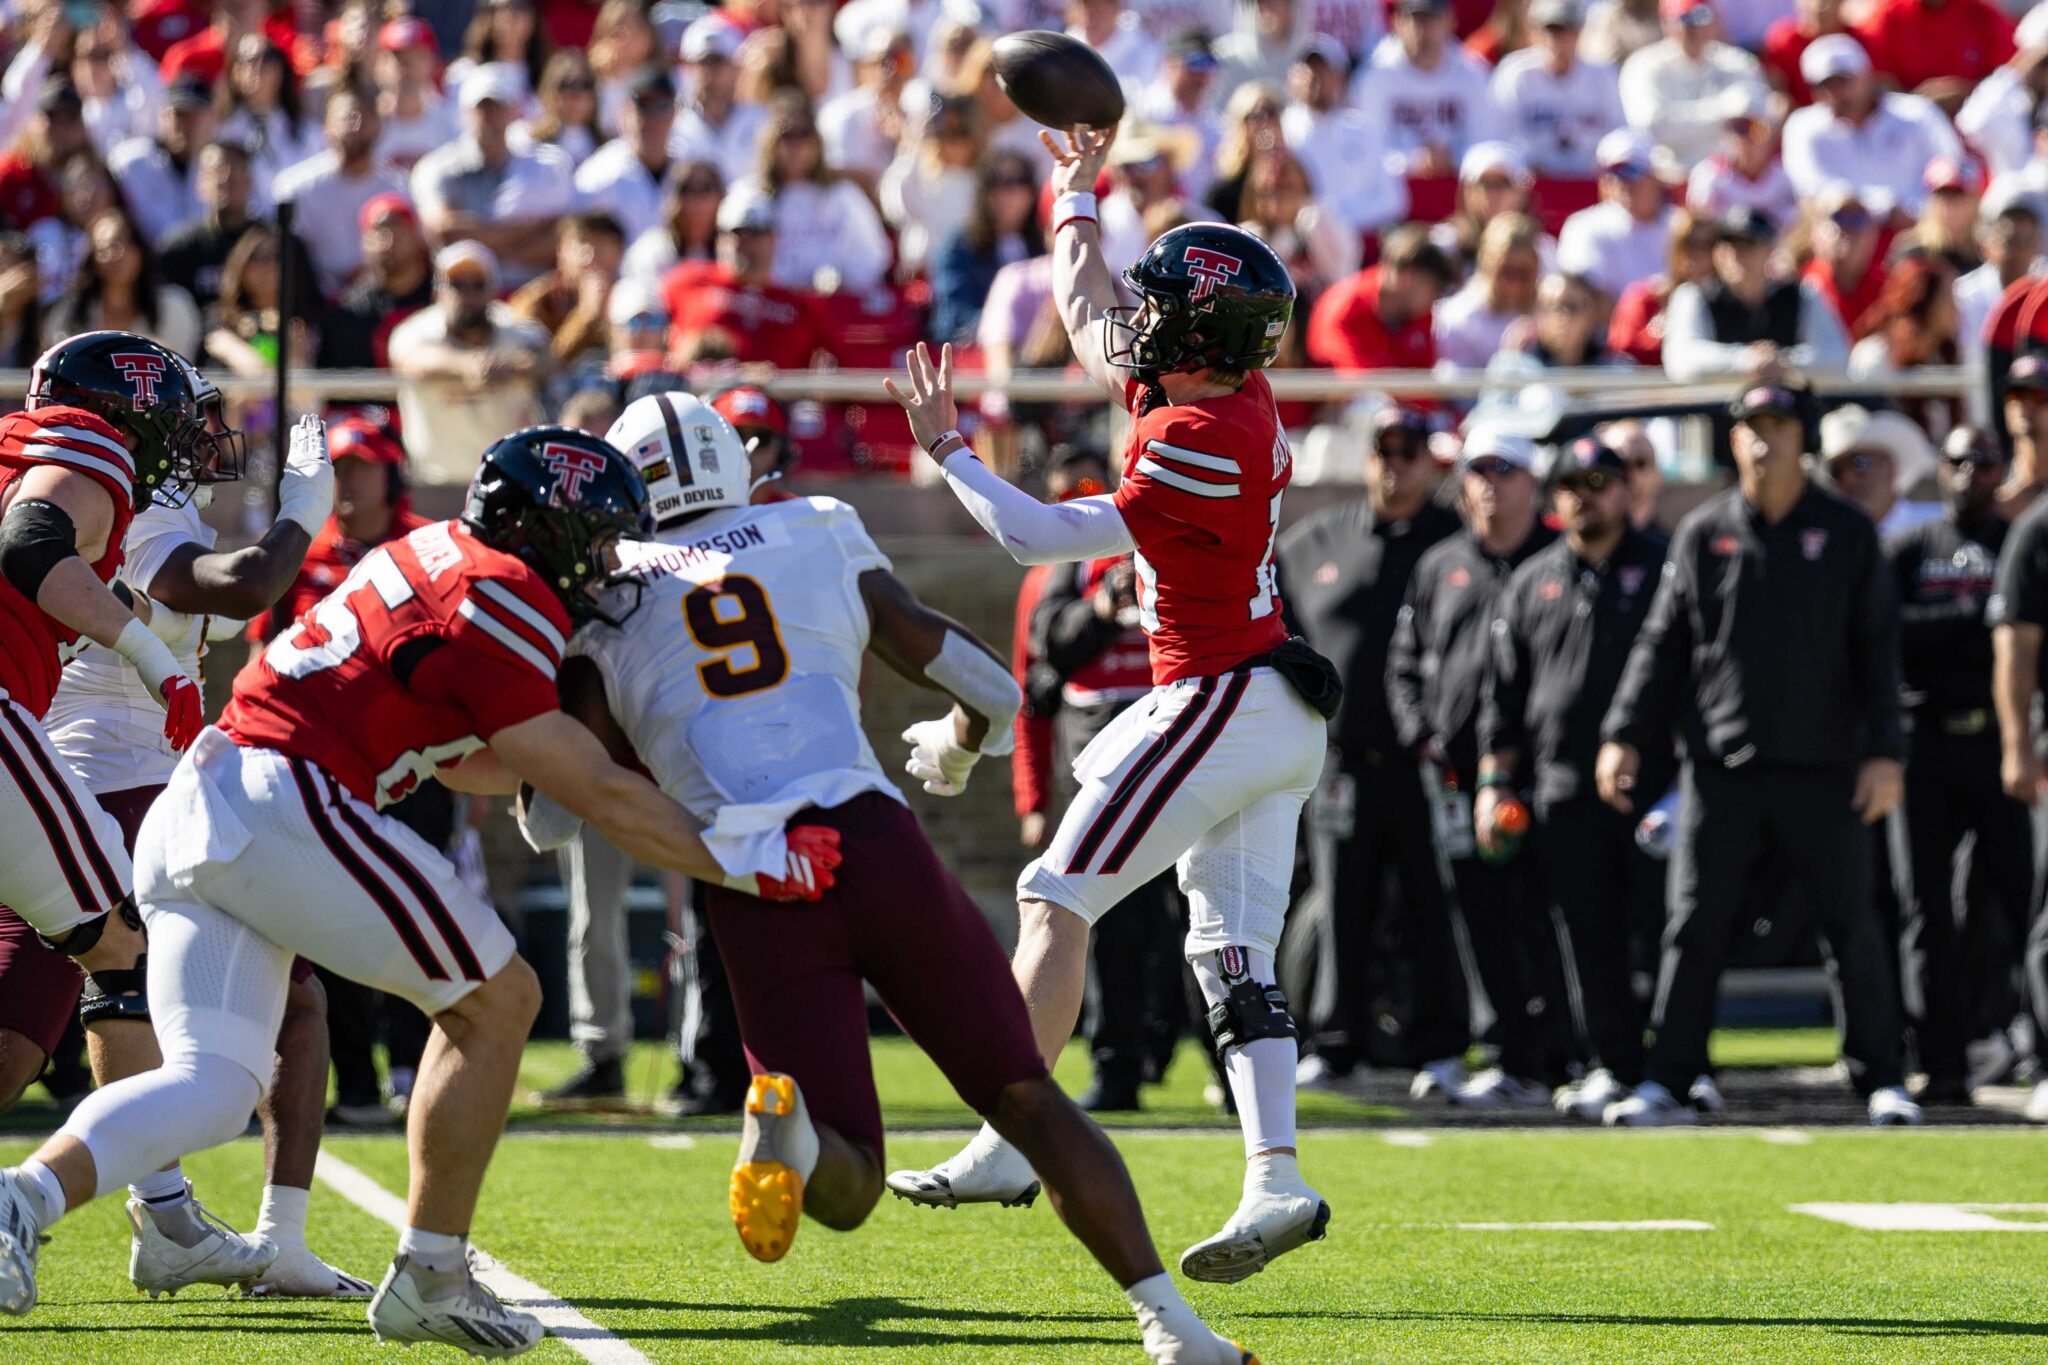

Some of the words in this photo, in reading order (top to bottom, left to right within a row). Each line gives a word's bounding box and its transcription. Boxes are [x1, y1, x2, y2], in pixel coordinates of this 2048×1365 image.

[656, 494, 681, 514] SUN
[684, 488, 725, 505] DEVILS
[631, 524, 766, 582] THOMPSON
[682, 572, 791, 700] 9
